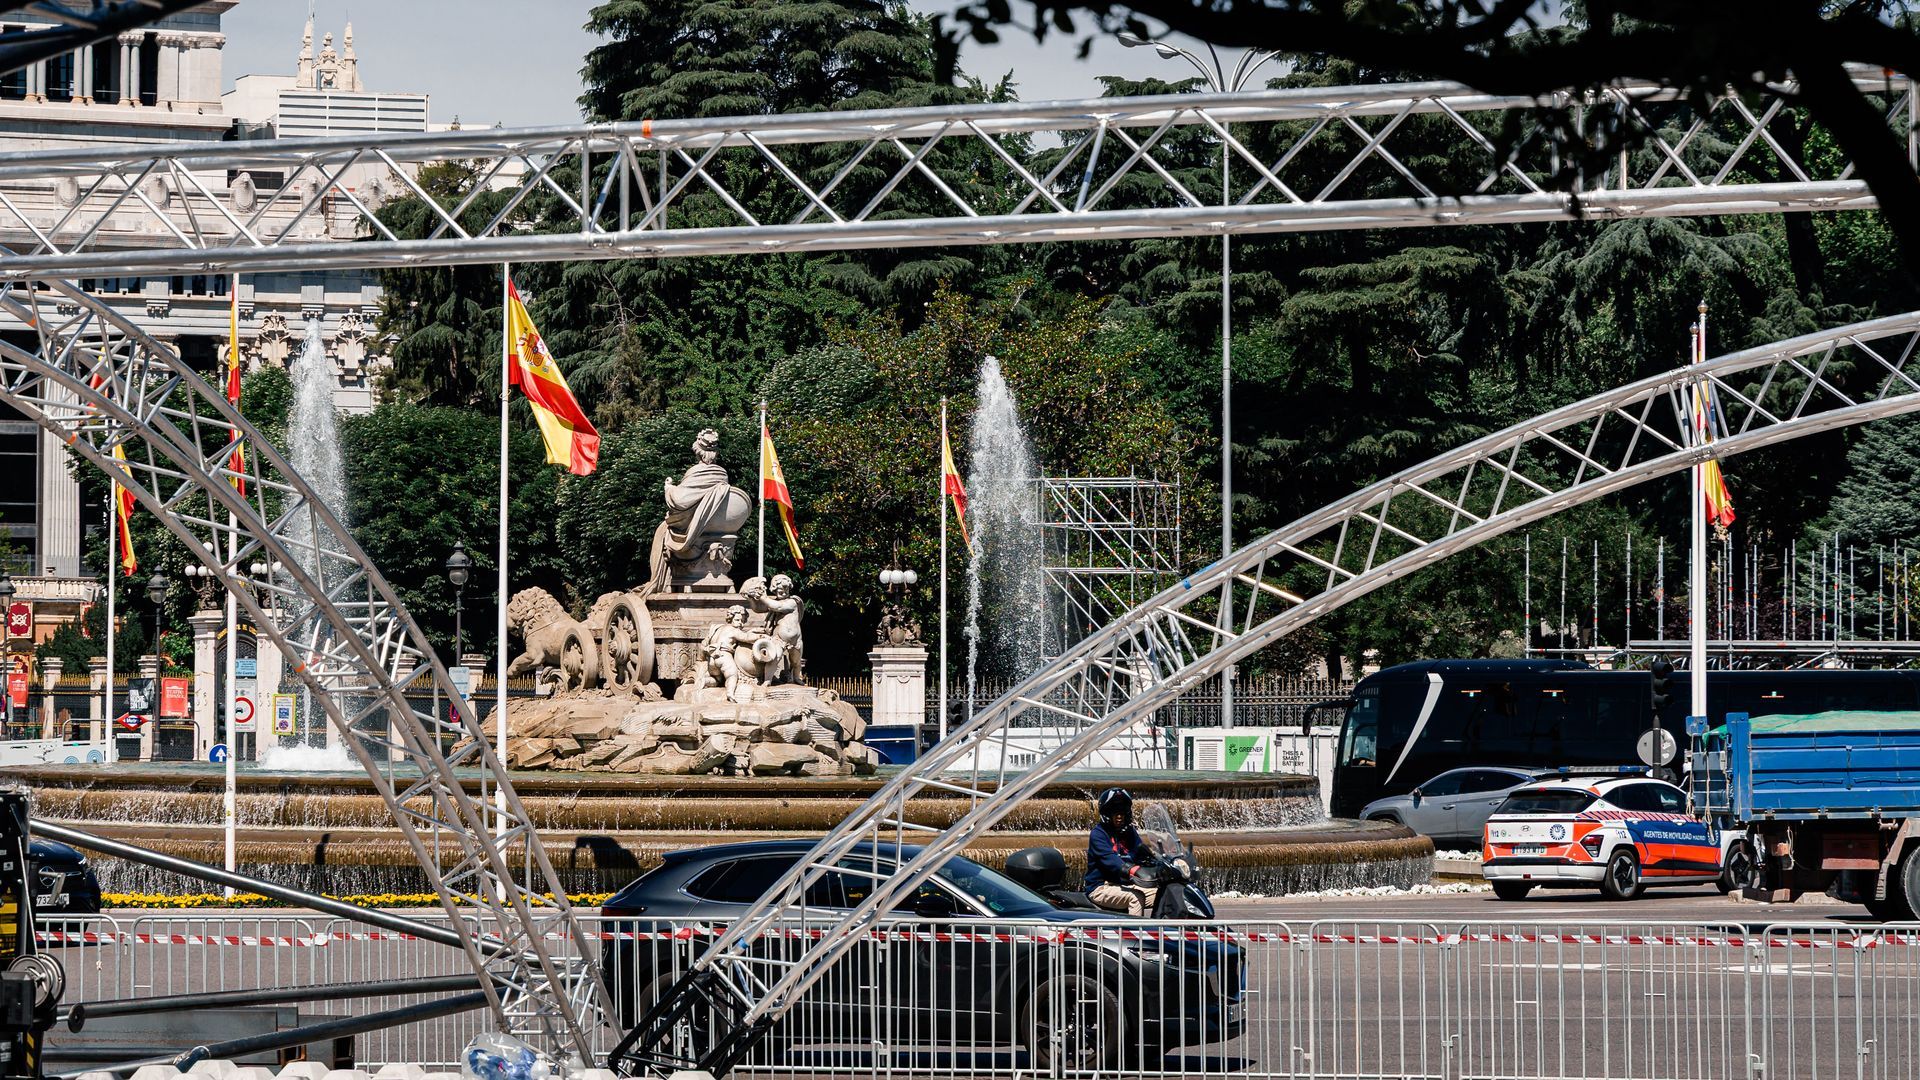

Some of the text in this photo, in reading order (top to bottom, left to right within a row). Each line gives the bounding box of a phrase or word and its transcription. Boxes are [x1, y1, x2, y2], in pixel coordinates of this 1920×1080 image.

[1643, 830, 1663, 838] AGENTES
[1662, 831, 1669, 839] DE
[1668, 831, 1692, 840] MOVILIDAD
